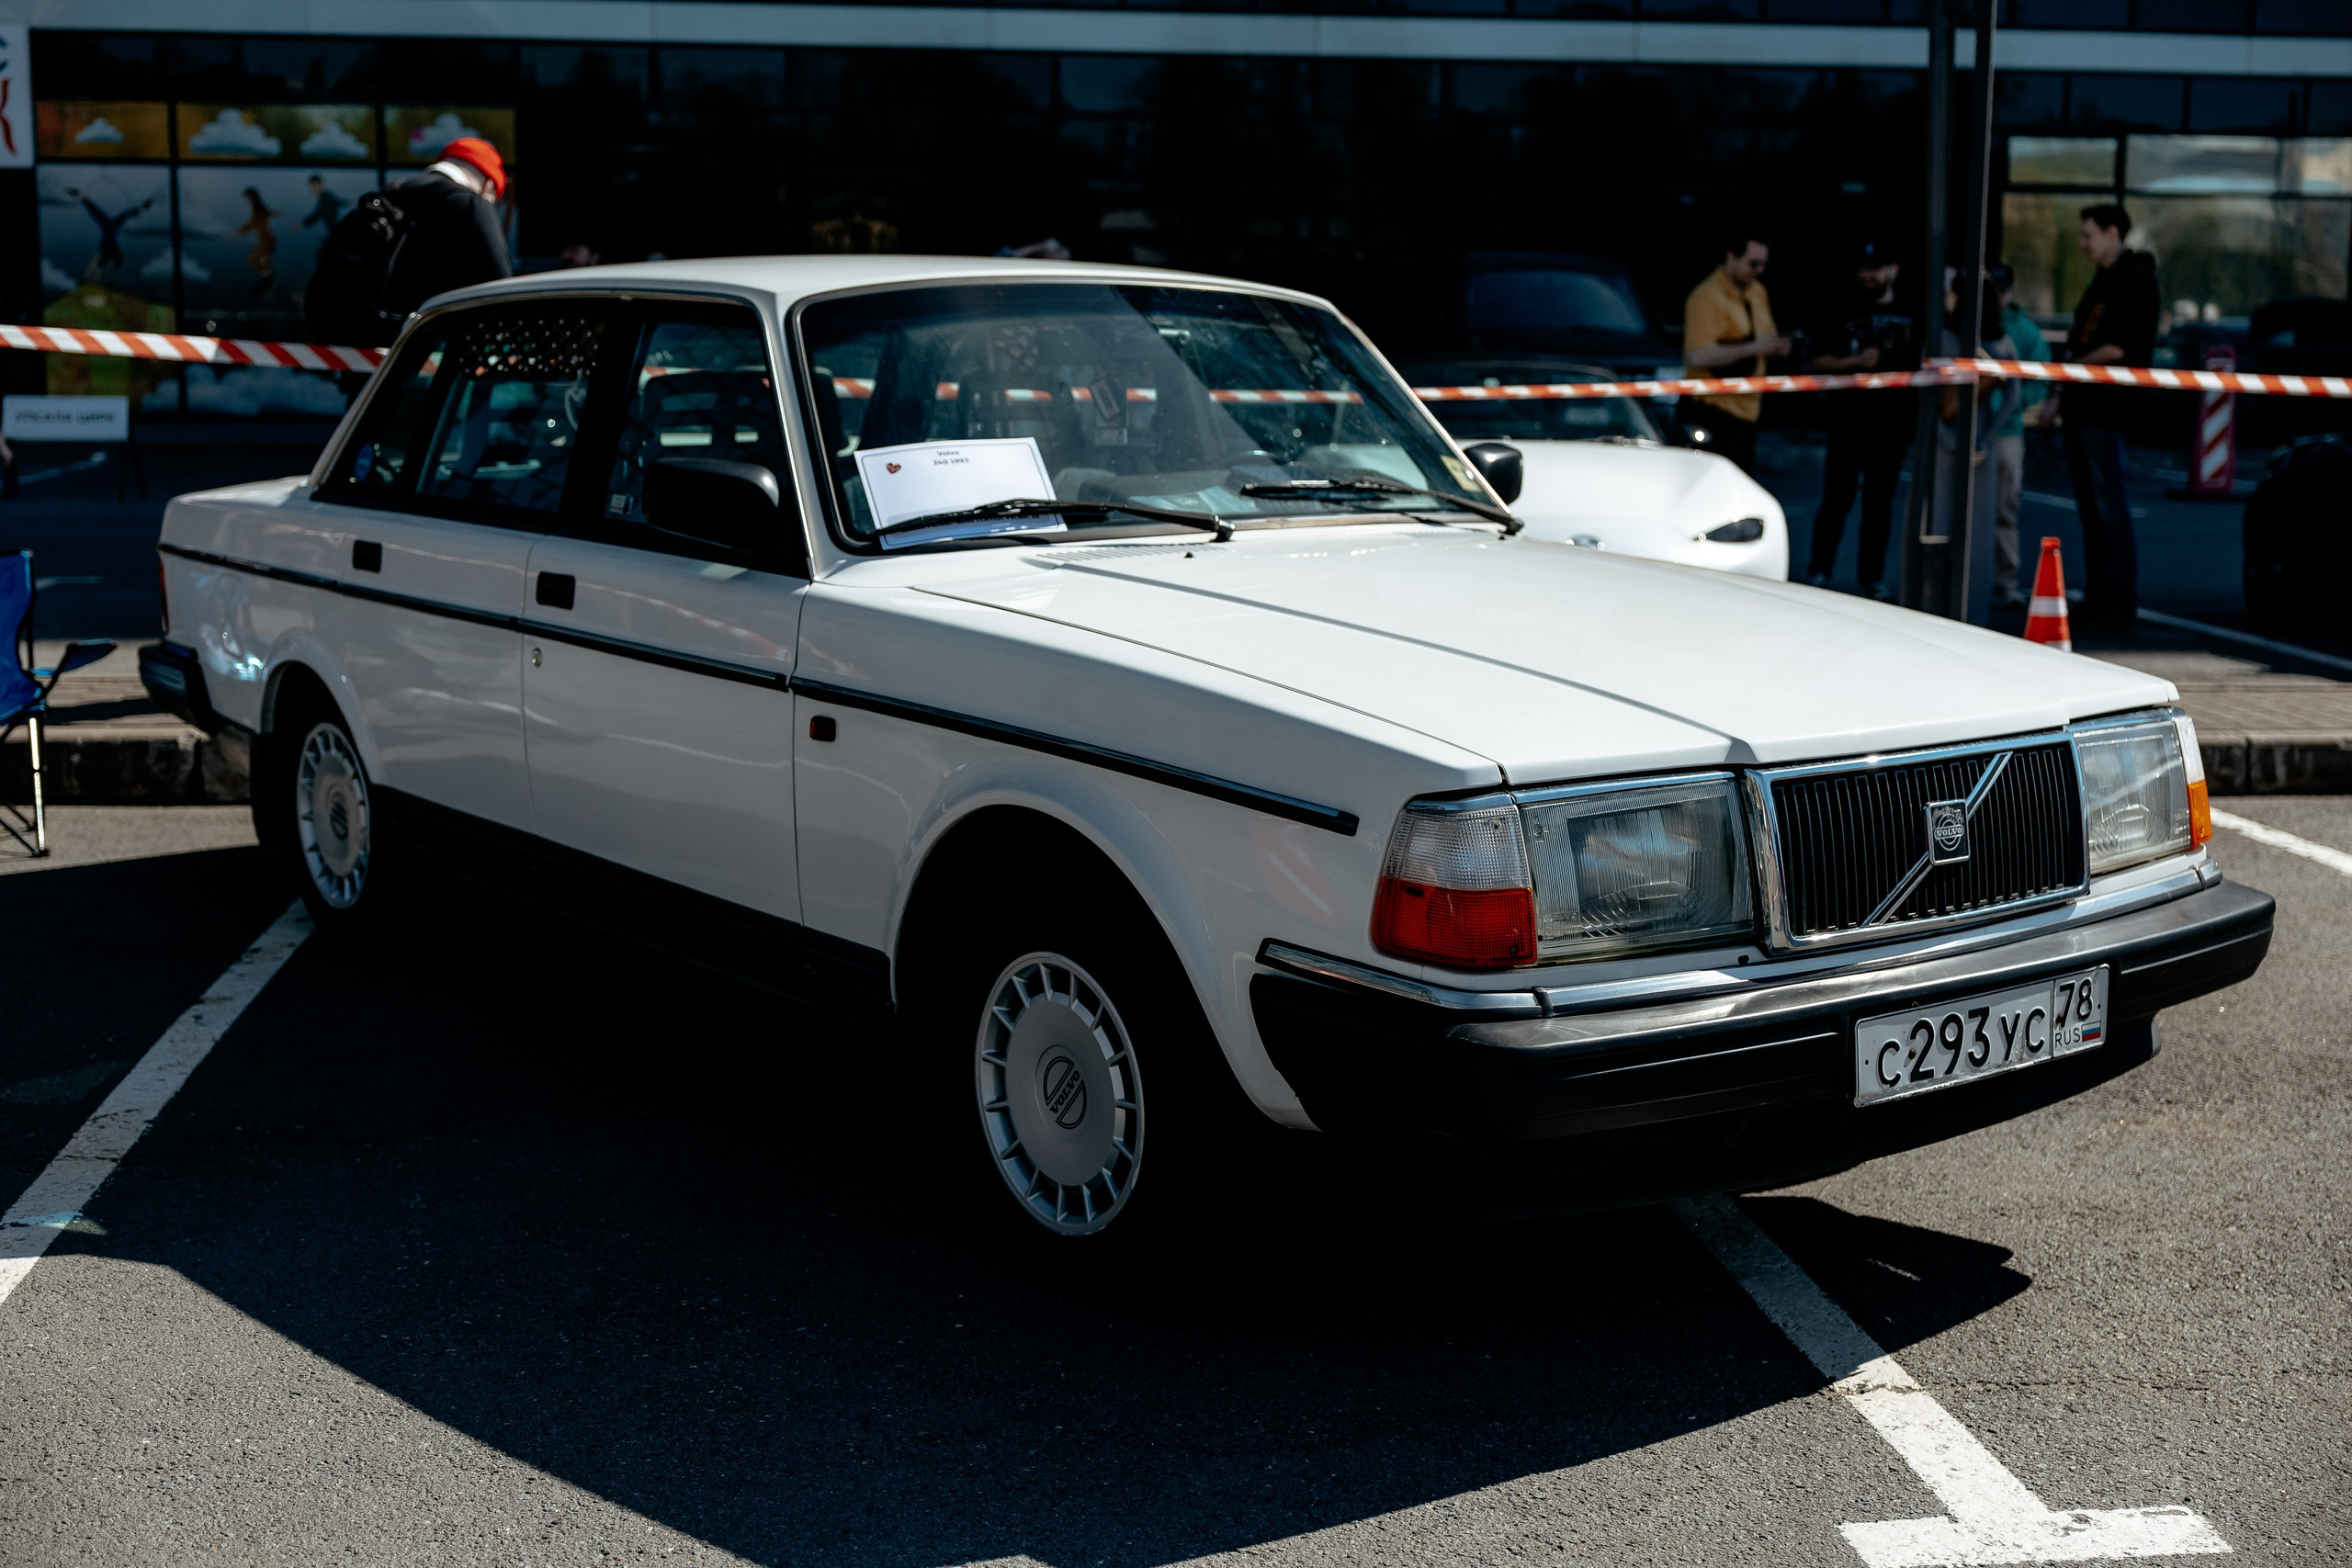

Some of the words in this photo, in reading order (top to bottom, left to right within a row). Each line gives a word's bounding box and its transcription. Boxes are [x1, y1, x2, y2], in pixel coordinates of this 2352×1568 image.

[1936, 827, 1962, 837] VOLVO
[2059, 976, 2092, 1027] 78
[2055, 1028, 2081, 1046] RUS
[1050, 1069, 1080, 1115] VOLVO
